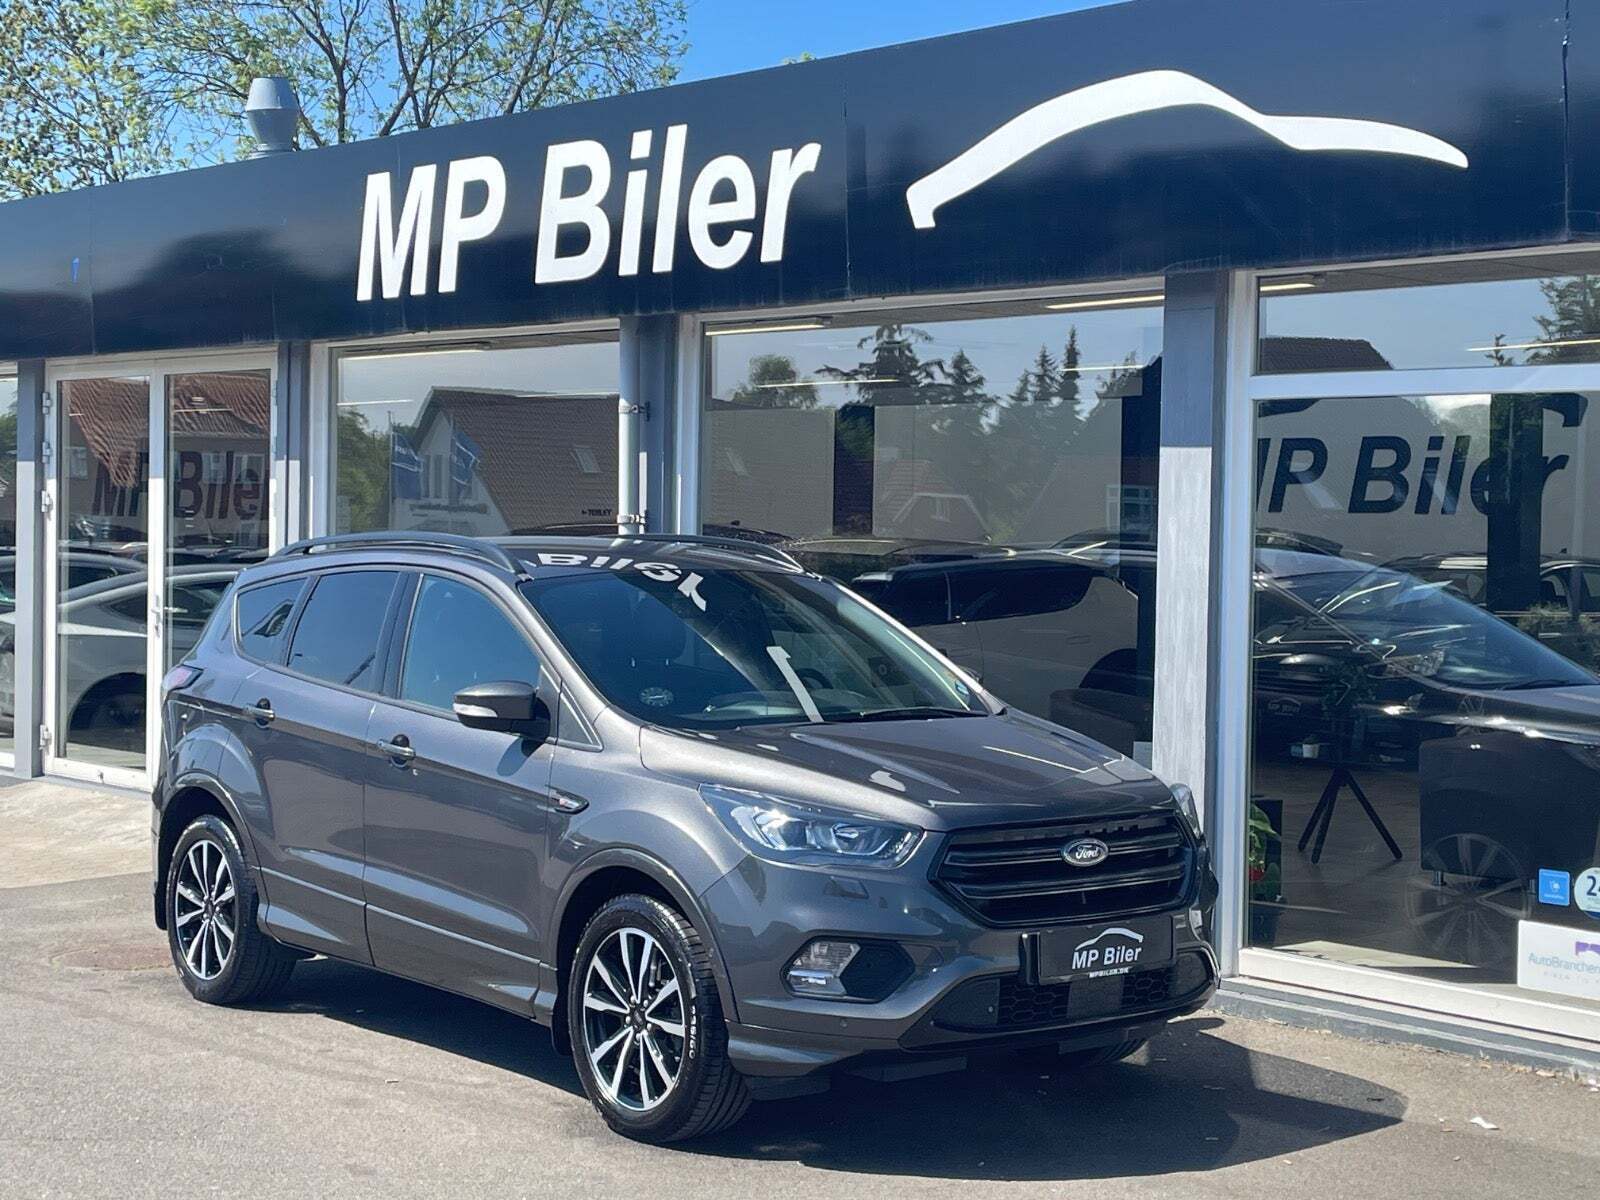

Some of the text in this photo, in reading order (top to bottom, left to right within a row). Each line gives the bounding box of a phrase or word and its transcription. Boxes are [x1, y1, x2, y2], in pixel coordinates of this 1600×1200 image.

[357, 123, 822, 302] MP Biler
[1075, 844, 1100, 860] Ford
[1586, 875, 1600, 897] 2
[1072, 945, 1142, 970] MP Biler
